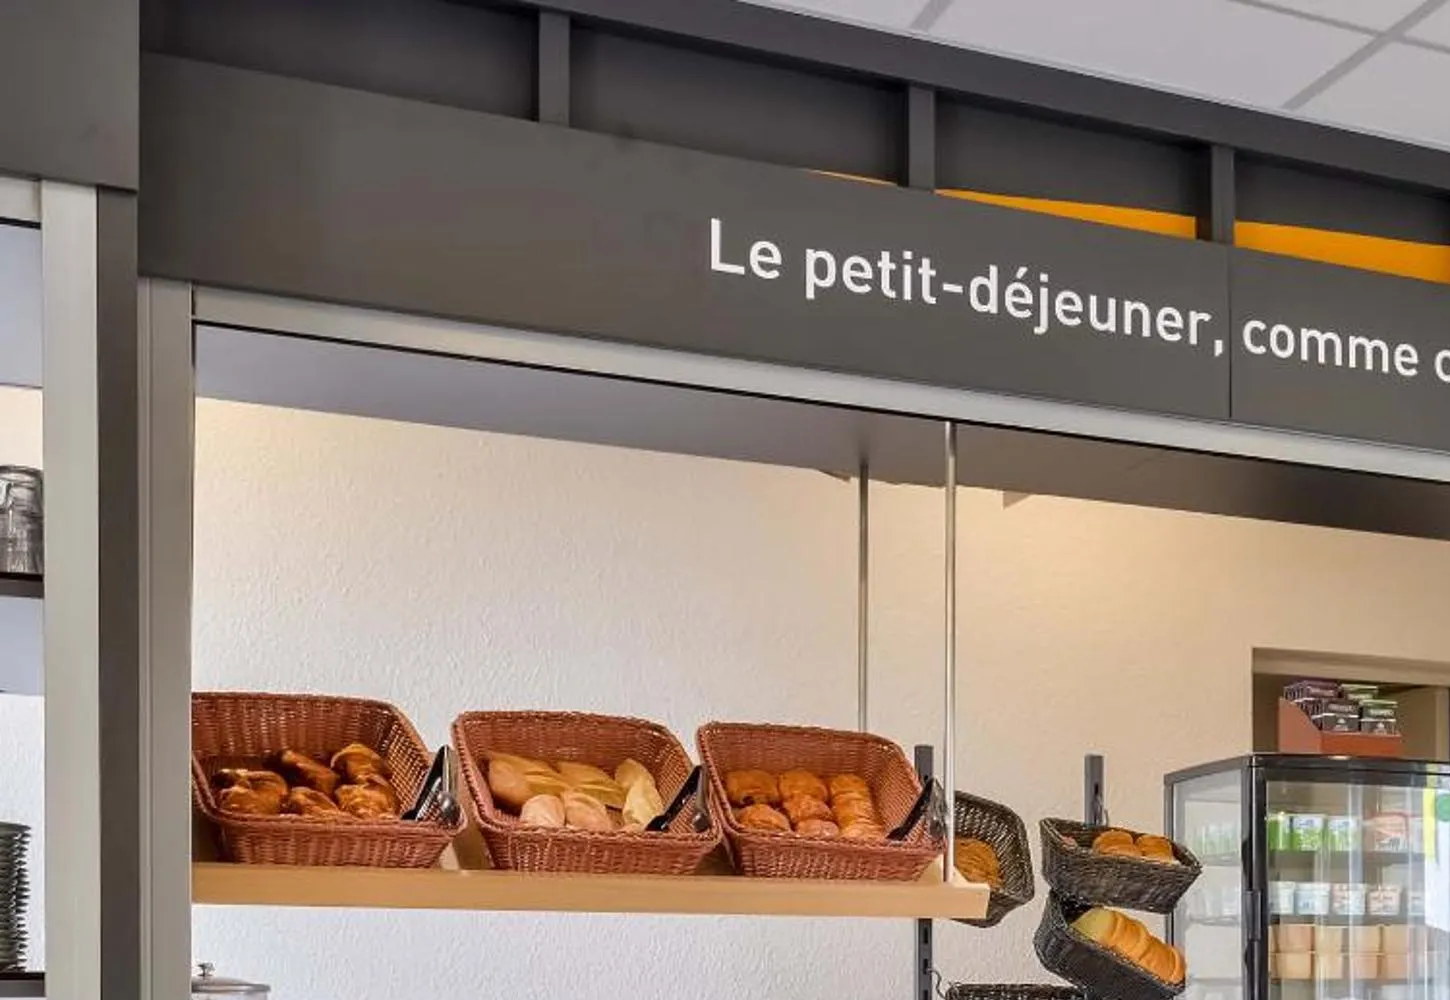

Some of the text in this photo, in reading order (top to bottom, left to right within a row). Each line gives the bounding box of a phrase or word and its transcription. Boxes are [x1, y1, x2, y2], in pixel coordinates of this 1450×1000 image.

[709, 218, 782, 280] Le
[805, 247, 1223, 357] petit-déjeuner,
[1242, 319, 1418, 377] comme
